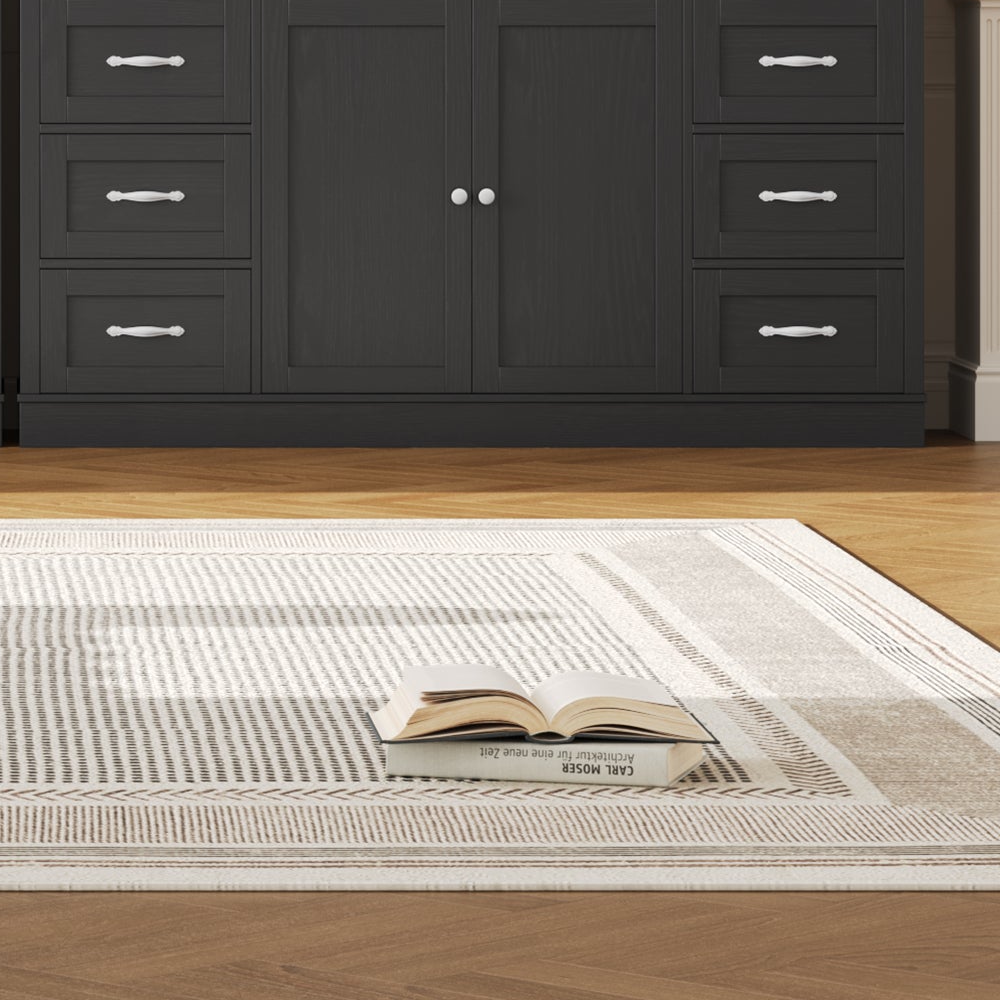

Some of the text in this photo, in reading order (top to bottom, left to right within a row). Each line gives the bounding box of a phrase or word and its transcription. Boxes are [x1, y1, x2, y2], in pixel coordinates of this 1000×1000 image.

[480, 747, 634, 764] Architektur für eine neue Zeit
[562, 763, 634, 776] CARL MOSER
